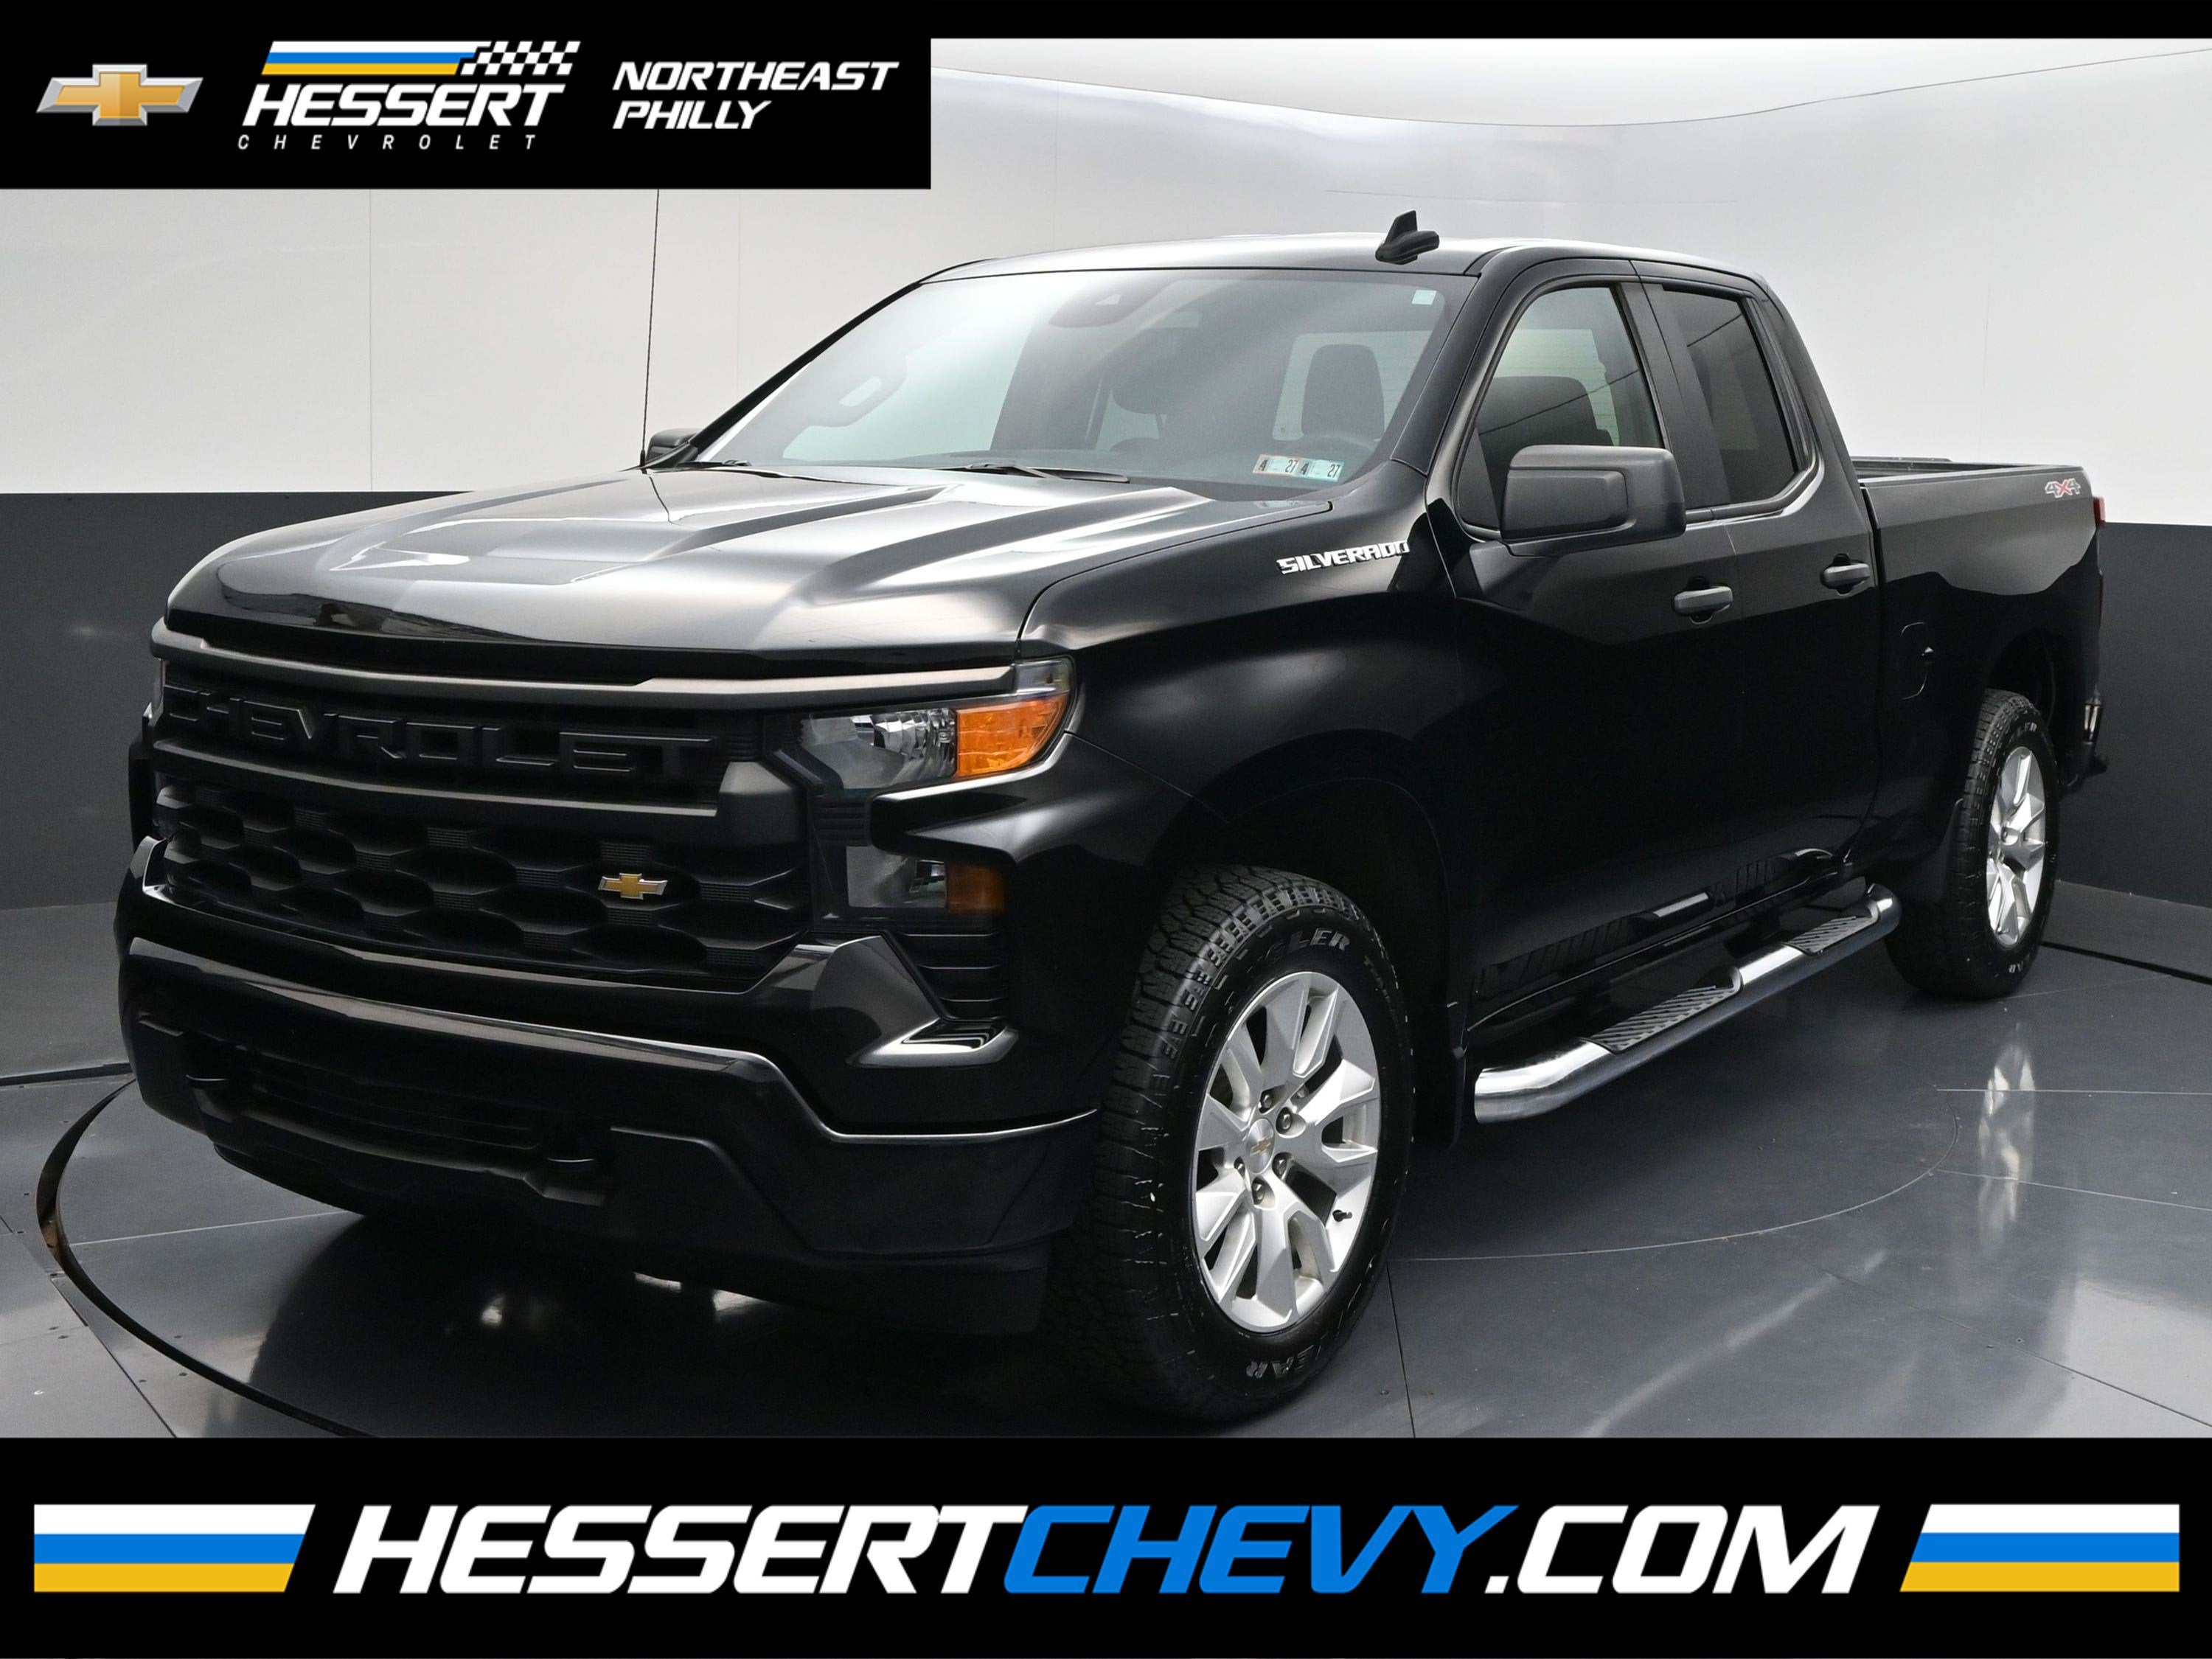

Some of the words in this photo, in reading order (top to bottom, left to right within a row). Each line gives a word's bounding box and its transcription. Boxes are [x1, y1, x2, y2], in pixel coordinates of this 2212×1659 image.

[1284, 459, 1298, 473] 27
[1326, 463, 1340, 479] 27
[1276, 540, 1411, 575] SILVERADO
